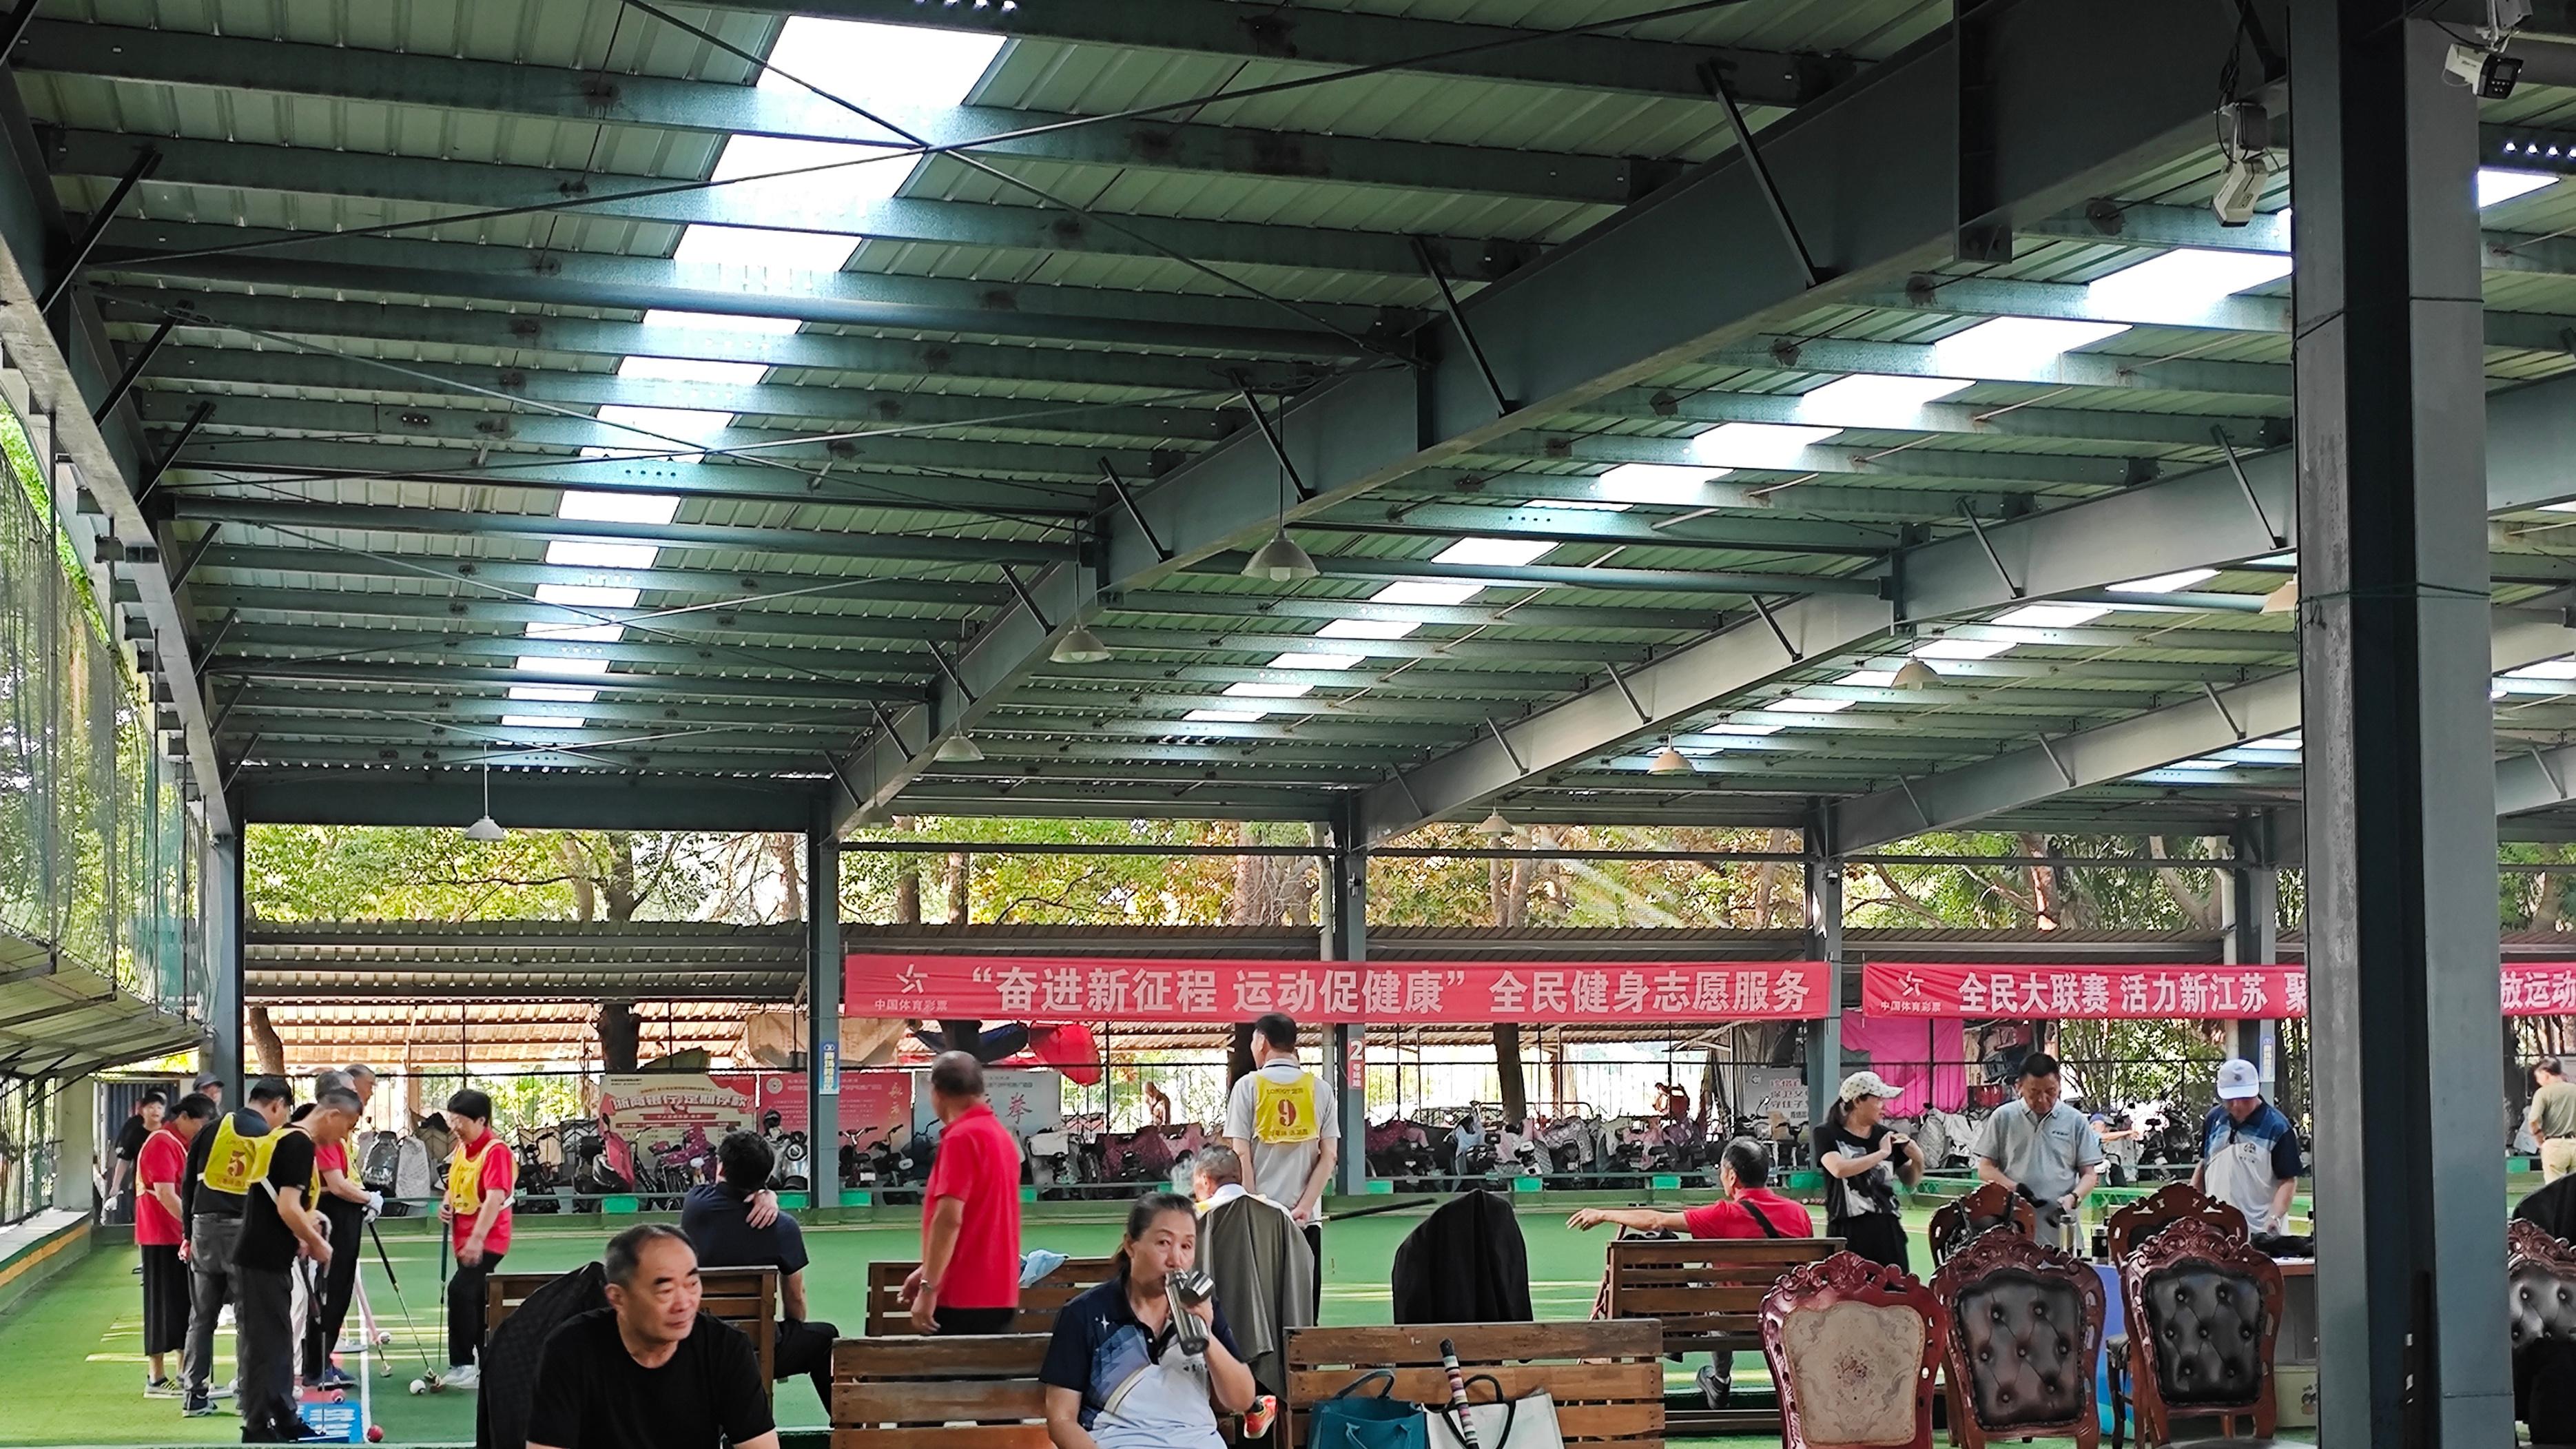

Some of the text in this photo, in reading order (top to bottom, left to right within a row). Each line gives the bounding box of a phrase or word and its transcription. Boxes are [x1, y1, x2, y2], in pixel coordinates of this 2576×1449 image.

[972, 967, 1811, 1014] “奋进新征程 运动促健康” 全民健身志愿服务
[1958, 972, 2109, 1013] 全民大联赛
[2121, 972, 2268, 1014] 活力新江苏
[874, 998, 948, 1014] 中国体育彩票
[1881, 1000, 1941, 1012] 中国体育彩票
[1349, 1040, 1363, 1060] 2
[1278, 1099, 1297, 1127] 9
[227, 1150, 245, 1177] 5
